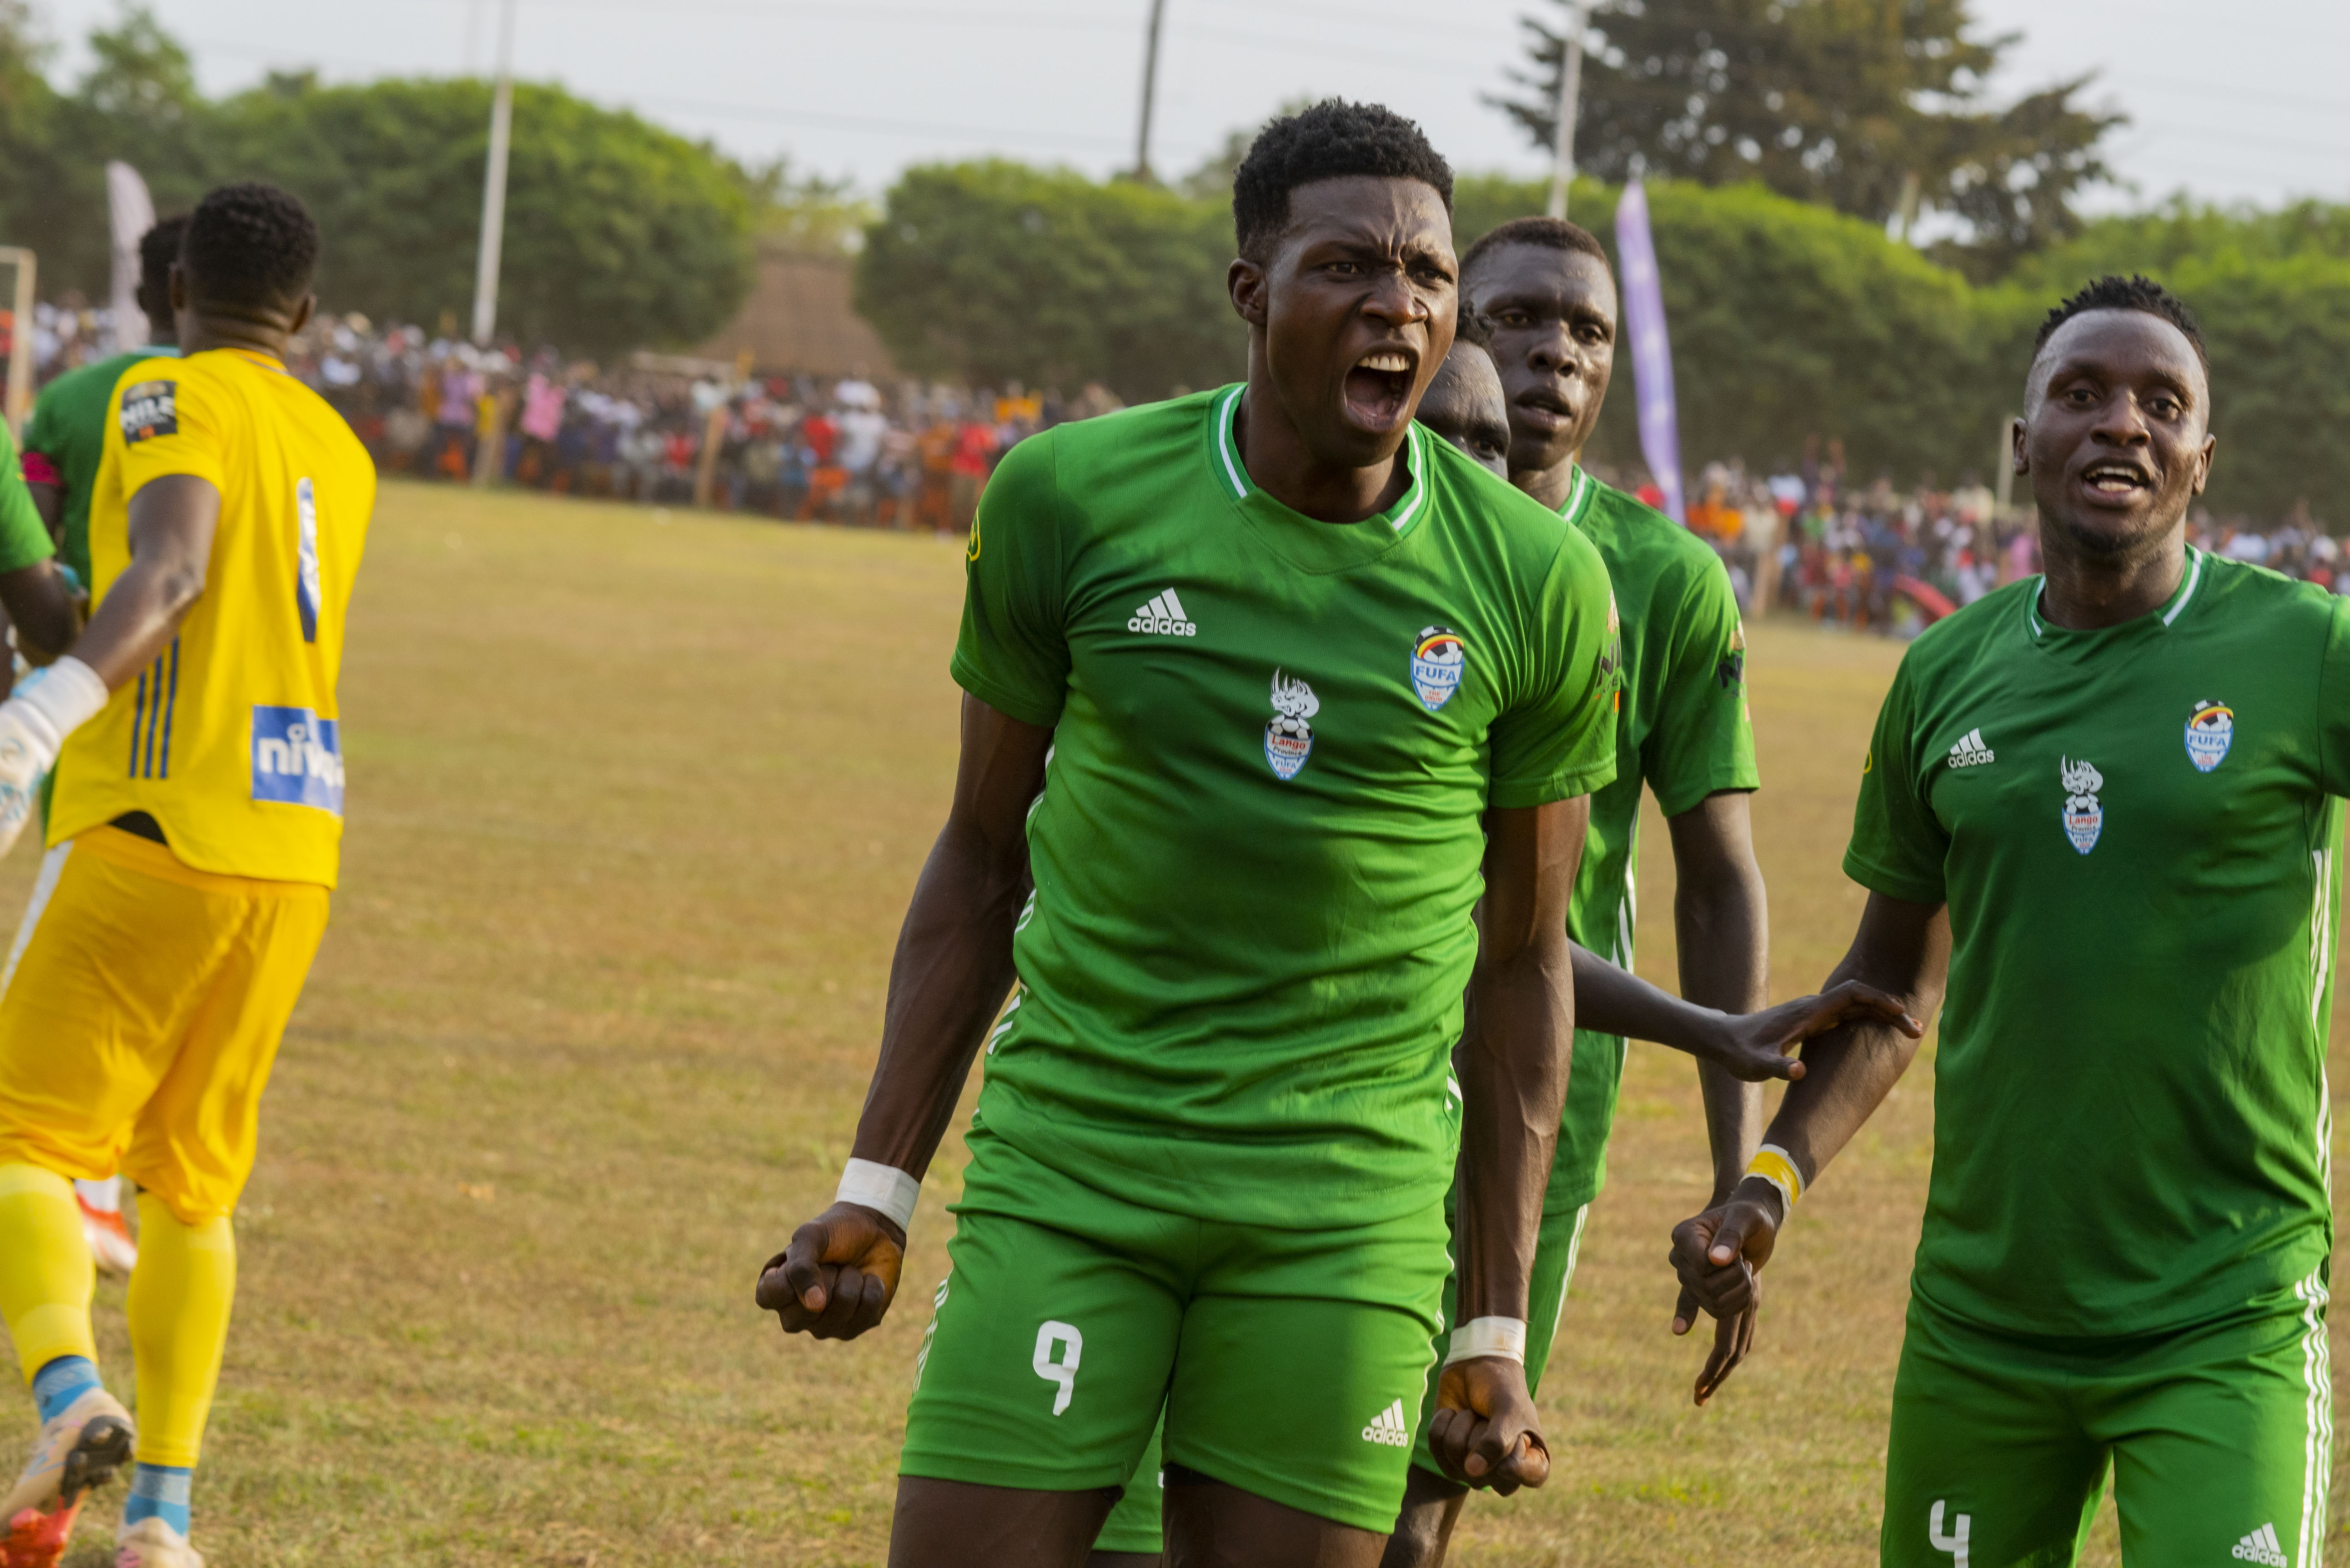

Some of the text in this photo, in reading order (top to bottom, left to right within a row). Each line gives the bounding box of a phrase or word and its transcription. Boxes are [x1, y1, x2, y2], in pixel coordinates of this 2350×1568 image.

[1127, 615, 1196, 637] adidas
[1415, 665, 1456, 681] FUFA
[1272, 734, 1306, 750] Lango
[2189, 734, 2227, 749] FUFA
[1275, 759, 1296, 769] FUFA
[1948, 749, 1994, 769] adidas
[2069, 814, 2098, 827] Lango
[1032, 1320, 1083, 1417] 9
[1361, 1426, 1409, 1448] adidas
[1929, 1499, 1971, 1568] 4
[2231, 1544, 2288, 1568] adidas
